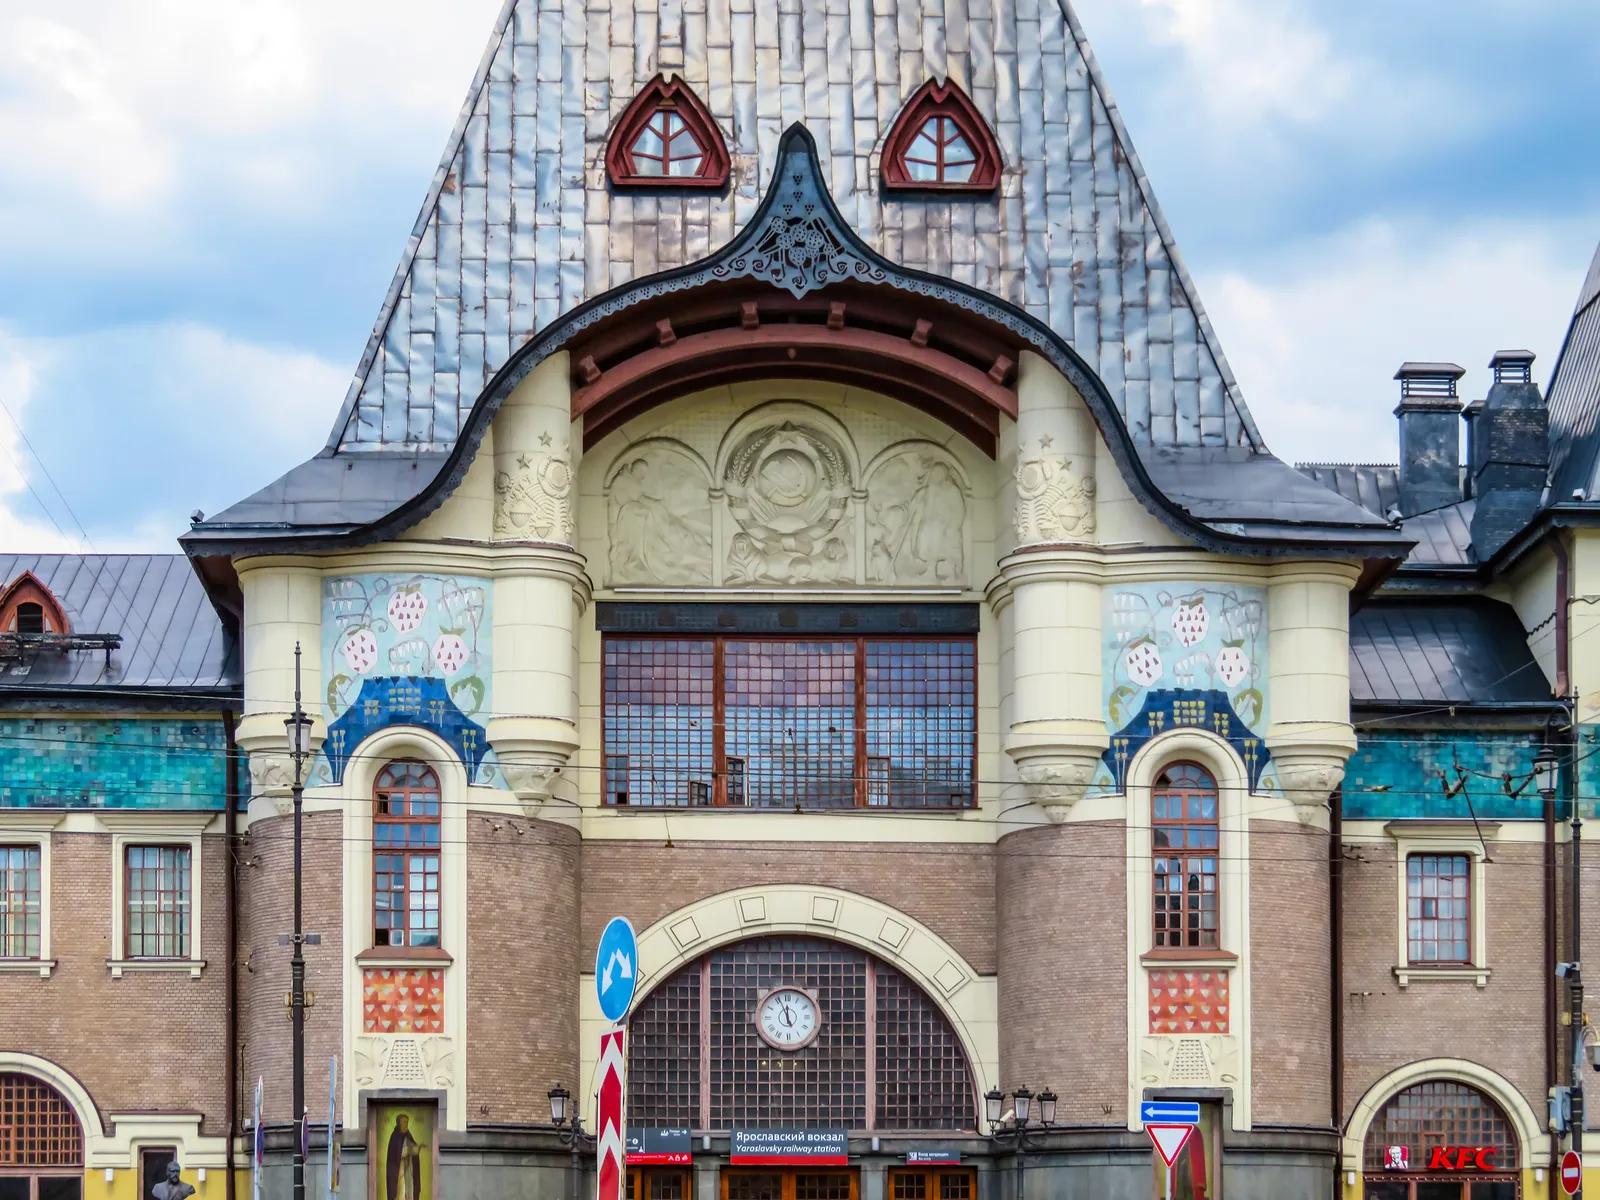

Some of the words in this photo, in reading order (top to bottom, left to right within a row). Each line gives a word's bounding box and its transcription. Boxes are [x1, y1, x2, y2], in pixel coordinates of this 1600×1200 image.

[736, 1131, 805, 1143] Ярославский
[807, 1133, 844, 1142] вокзал
[736, 1144, 782, 1154] Yaroslavsky
[783, 1144, 812, 1154] railway
[813, 1145, 841, 1153] station
[1428, 1147, 1497, 1170] KFC
